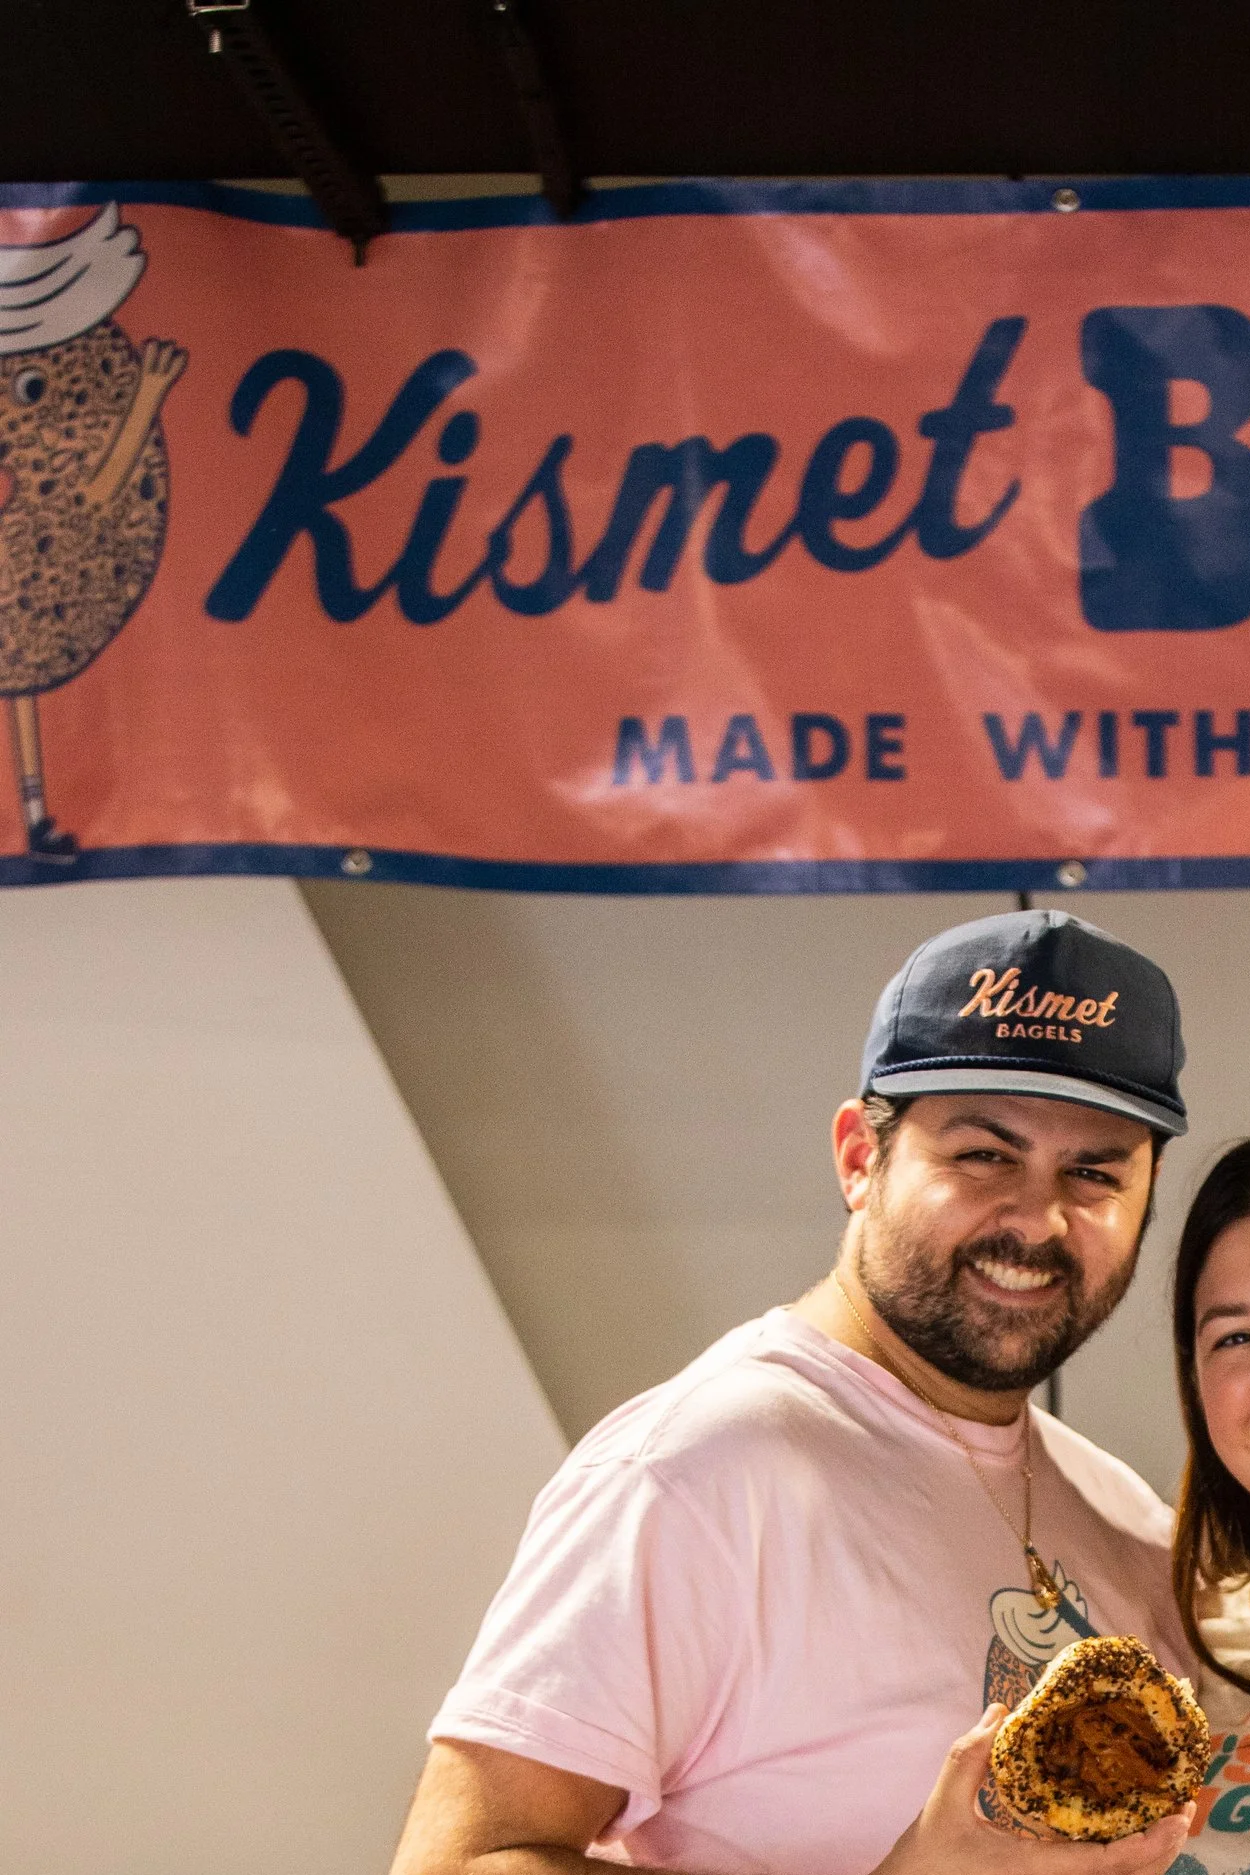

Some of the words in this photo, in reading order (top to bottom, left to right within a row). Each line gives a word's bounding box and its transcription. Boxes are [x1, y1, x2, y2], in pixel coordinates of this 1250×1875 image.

[204, 315, 1028, 625] Kismet
[612, 711, 907, 786] MADE
[958, 967, 1119, 1027] Kismet
[996, 1023, 1082, 1043] BAGELS
